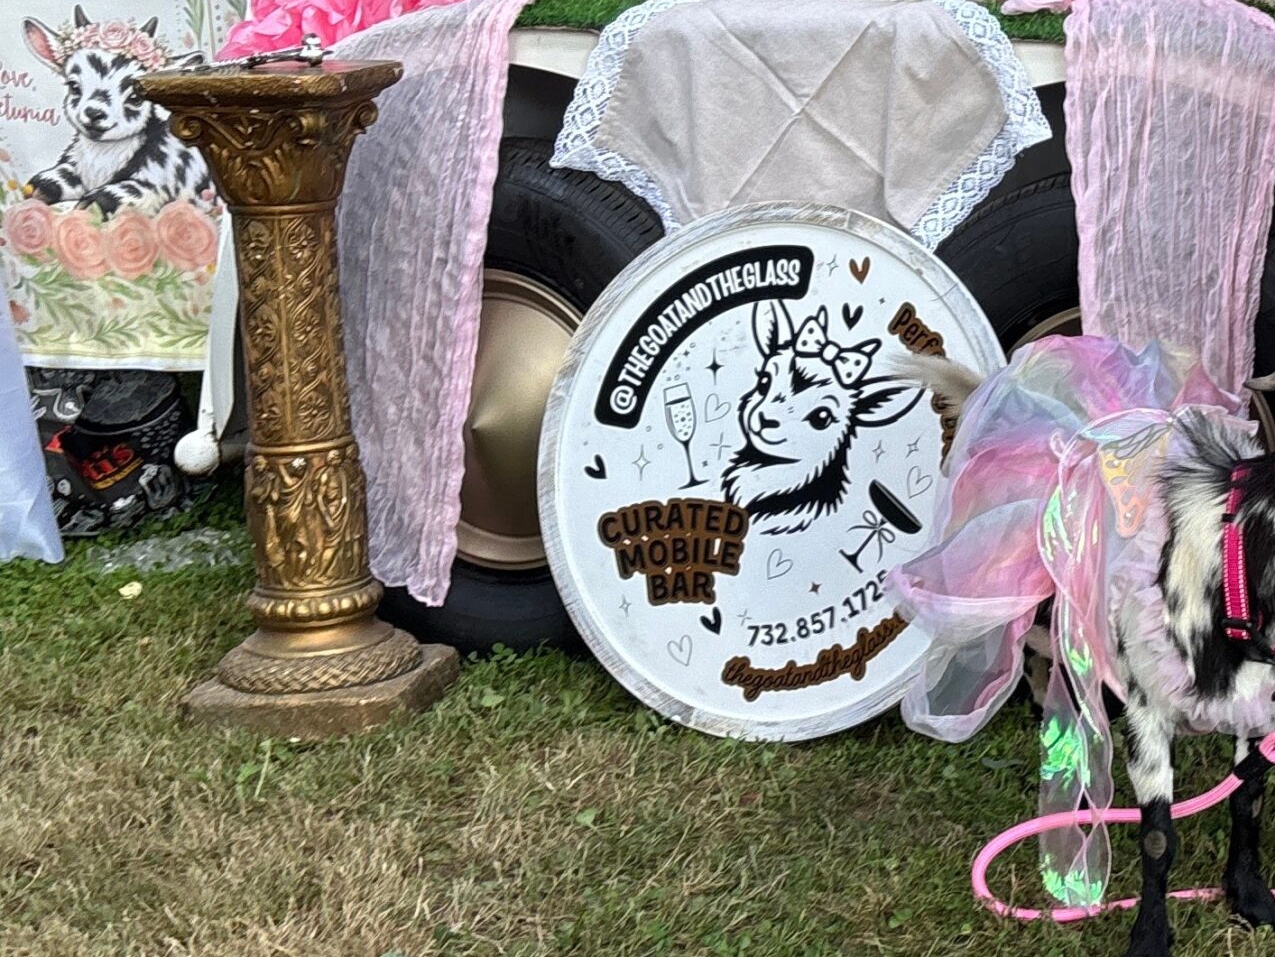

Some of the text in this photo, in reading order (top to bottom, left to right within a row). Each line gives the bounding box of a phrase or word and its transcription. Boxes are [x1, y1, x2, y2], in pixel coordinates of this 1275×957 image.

[0, 61, 37, 92] ove,
[609, 258, 801, 414] @THEGOATANDTHEGLASS
[601, 503, 743, 543] CURATED
[618, 537, 740, 575] MOBILE
[651, 571, 712, 600] BAR
